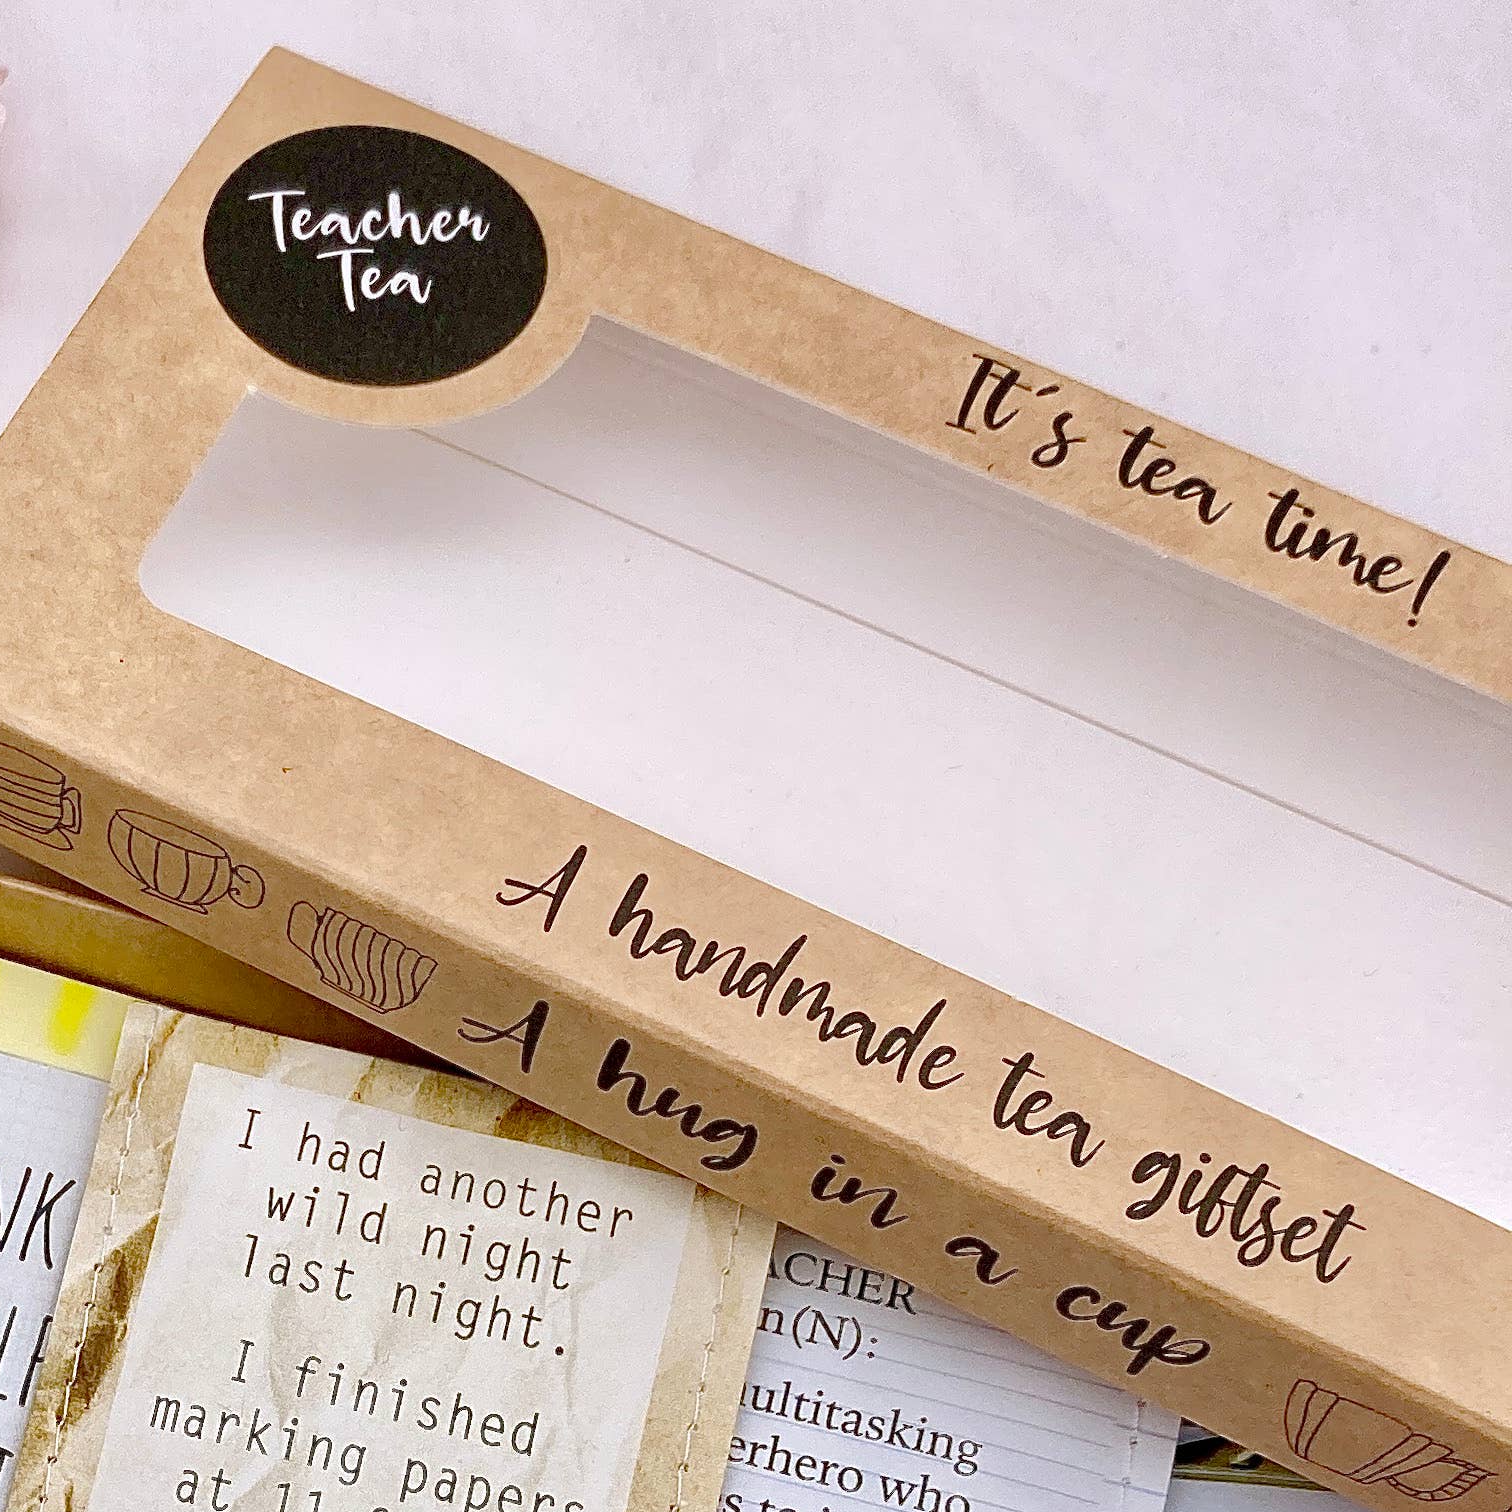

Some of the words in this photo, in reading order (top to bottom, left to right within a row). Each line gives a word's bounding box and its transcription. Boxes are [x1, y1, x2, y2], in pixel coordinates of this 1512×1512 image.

[248, 189, 490, 253] Teacher
[316, 247, 433, 312] Tea
[945, 353, 1087, 468] It's
[1123, 426, 1233, 525] tea
[1265, 489, 1451, 628] time!
[495, 844, 588, 933] A
[608, 872, 965, 1090] handmade
[993, 1050, 1106, 1168] tea
[1125, 1149, 1367, 1283] giftset
[238, 1108, 262, 1151] I
[297, 1121, 386, 1181] had
[419, 1163, 634, 1239] another
[457, 1000, 550, 1074] A
[596, 1037, 760, 1171] hug
[810, 1152, 909, 1230] in
[945, 1234, 1019, 1286] a
[1055, 1283, 1211, 1375] cup
[267, 1186, 388, 1245] wild
[422, 1224, 572, 1290] night
[242, 1233, 356, 1302] last
[392, 1281, 566, 1357] night.
[149, 1394, 367, 1485] marking
[231, 1339, 256, 1384] I
[295, 1355, 540, 1456] finished
[740, 1381, 983, 1476] ultitasking
[176, 1469, 232, 1512] at
